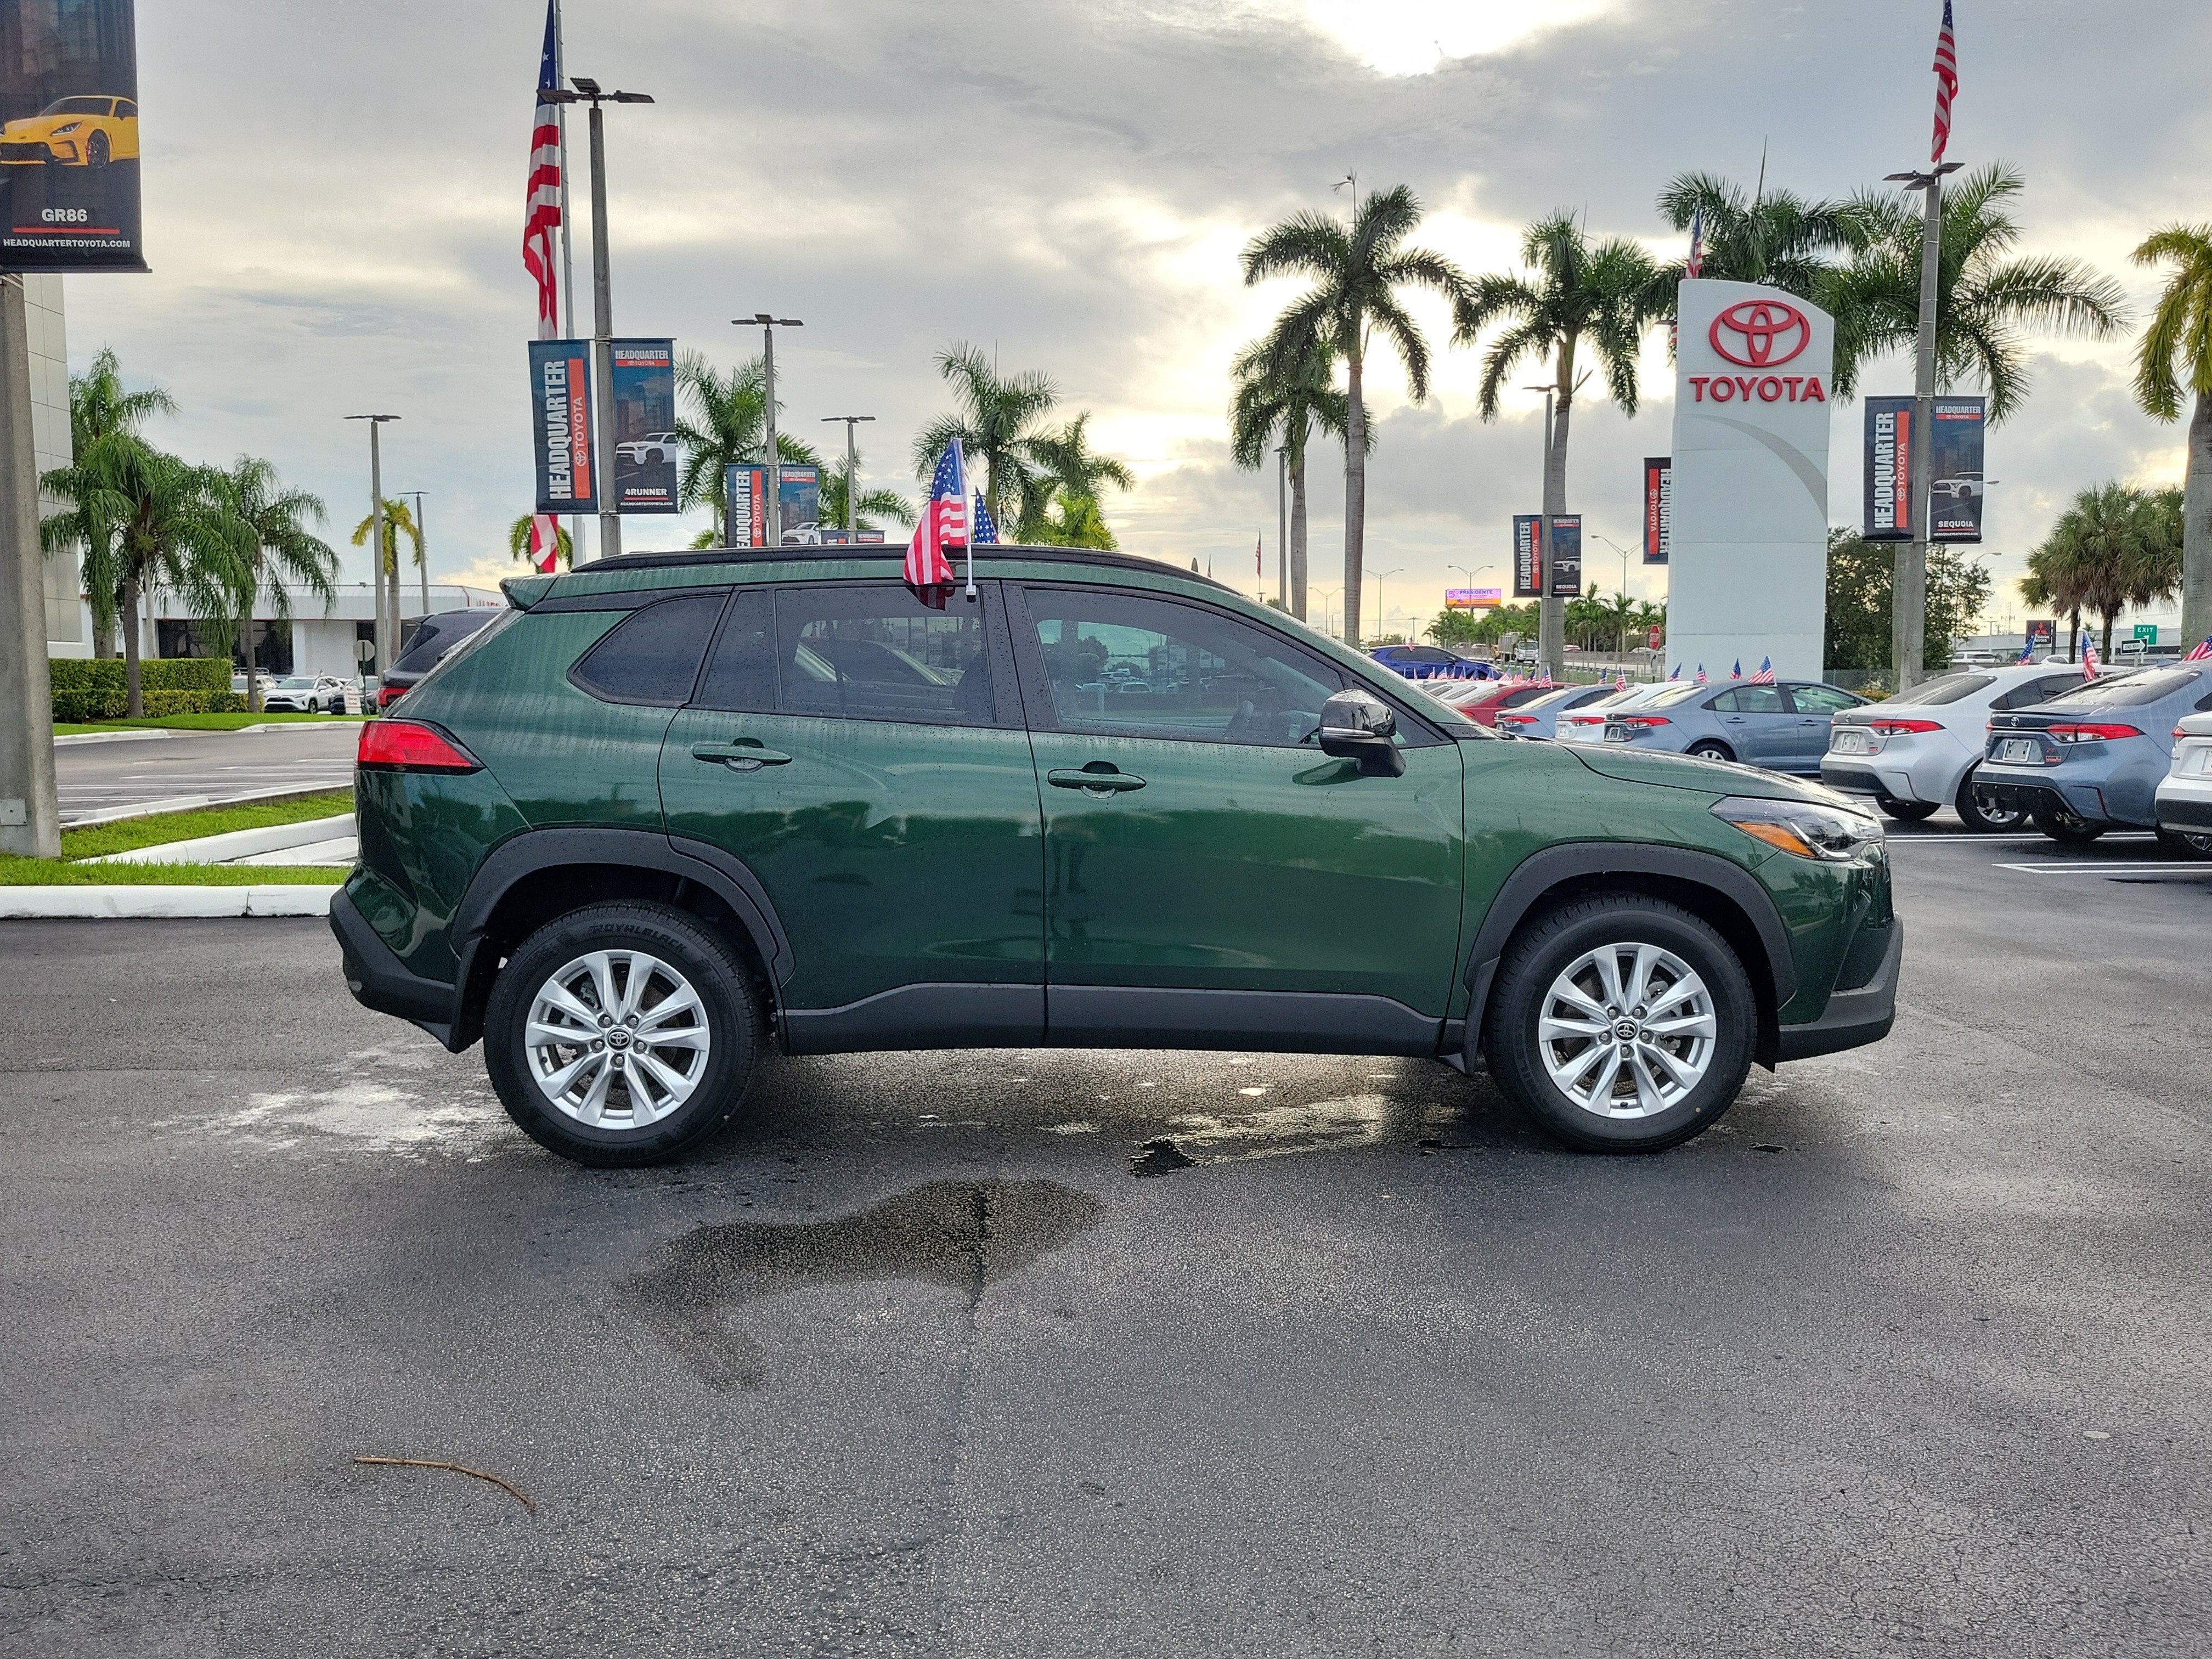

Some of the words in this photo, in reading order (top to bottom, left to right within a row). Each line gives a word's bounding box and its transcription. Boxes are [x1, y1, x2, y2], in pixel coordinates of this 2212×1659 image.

[42, 208, 88, 222] GR86
[3, 239, 131, 247] HEADQUARTERTOYOTA.COM
[616, 350, 668, 360] HEADQUARTER
[1689, 376, 1825, 402] TOYOTA
[1936, 405, 1980, 414] HEADQUARTER
[545, 360, 573, 499] HEADQUARTER
[574, 397, 587, 448] TOYOTA
[1874, 413, 1896, 528] HEADQUARTER
[1898, 442, 1906, 486] TOYOTA
[736, 471, 752, 548] EADQUARTER
[1520, 522, 1532, 589] HEADQUARTER
